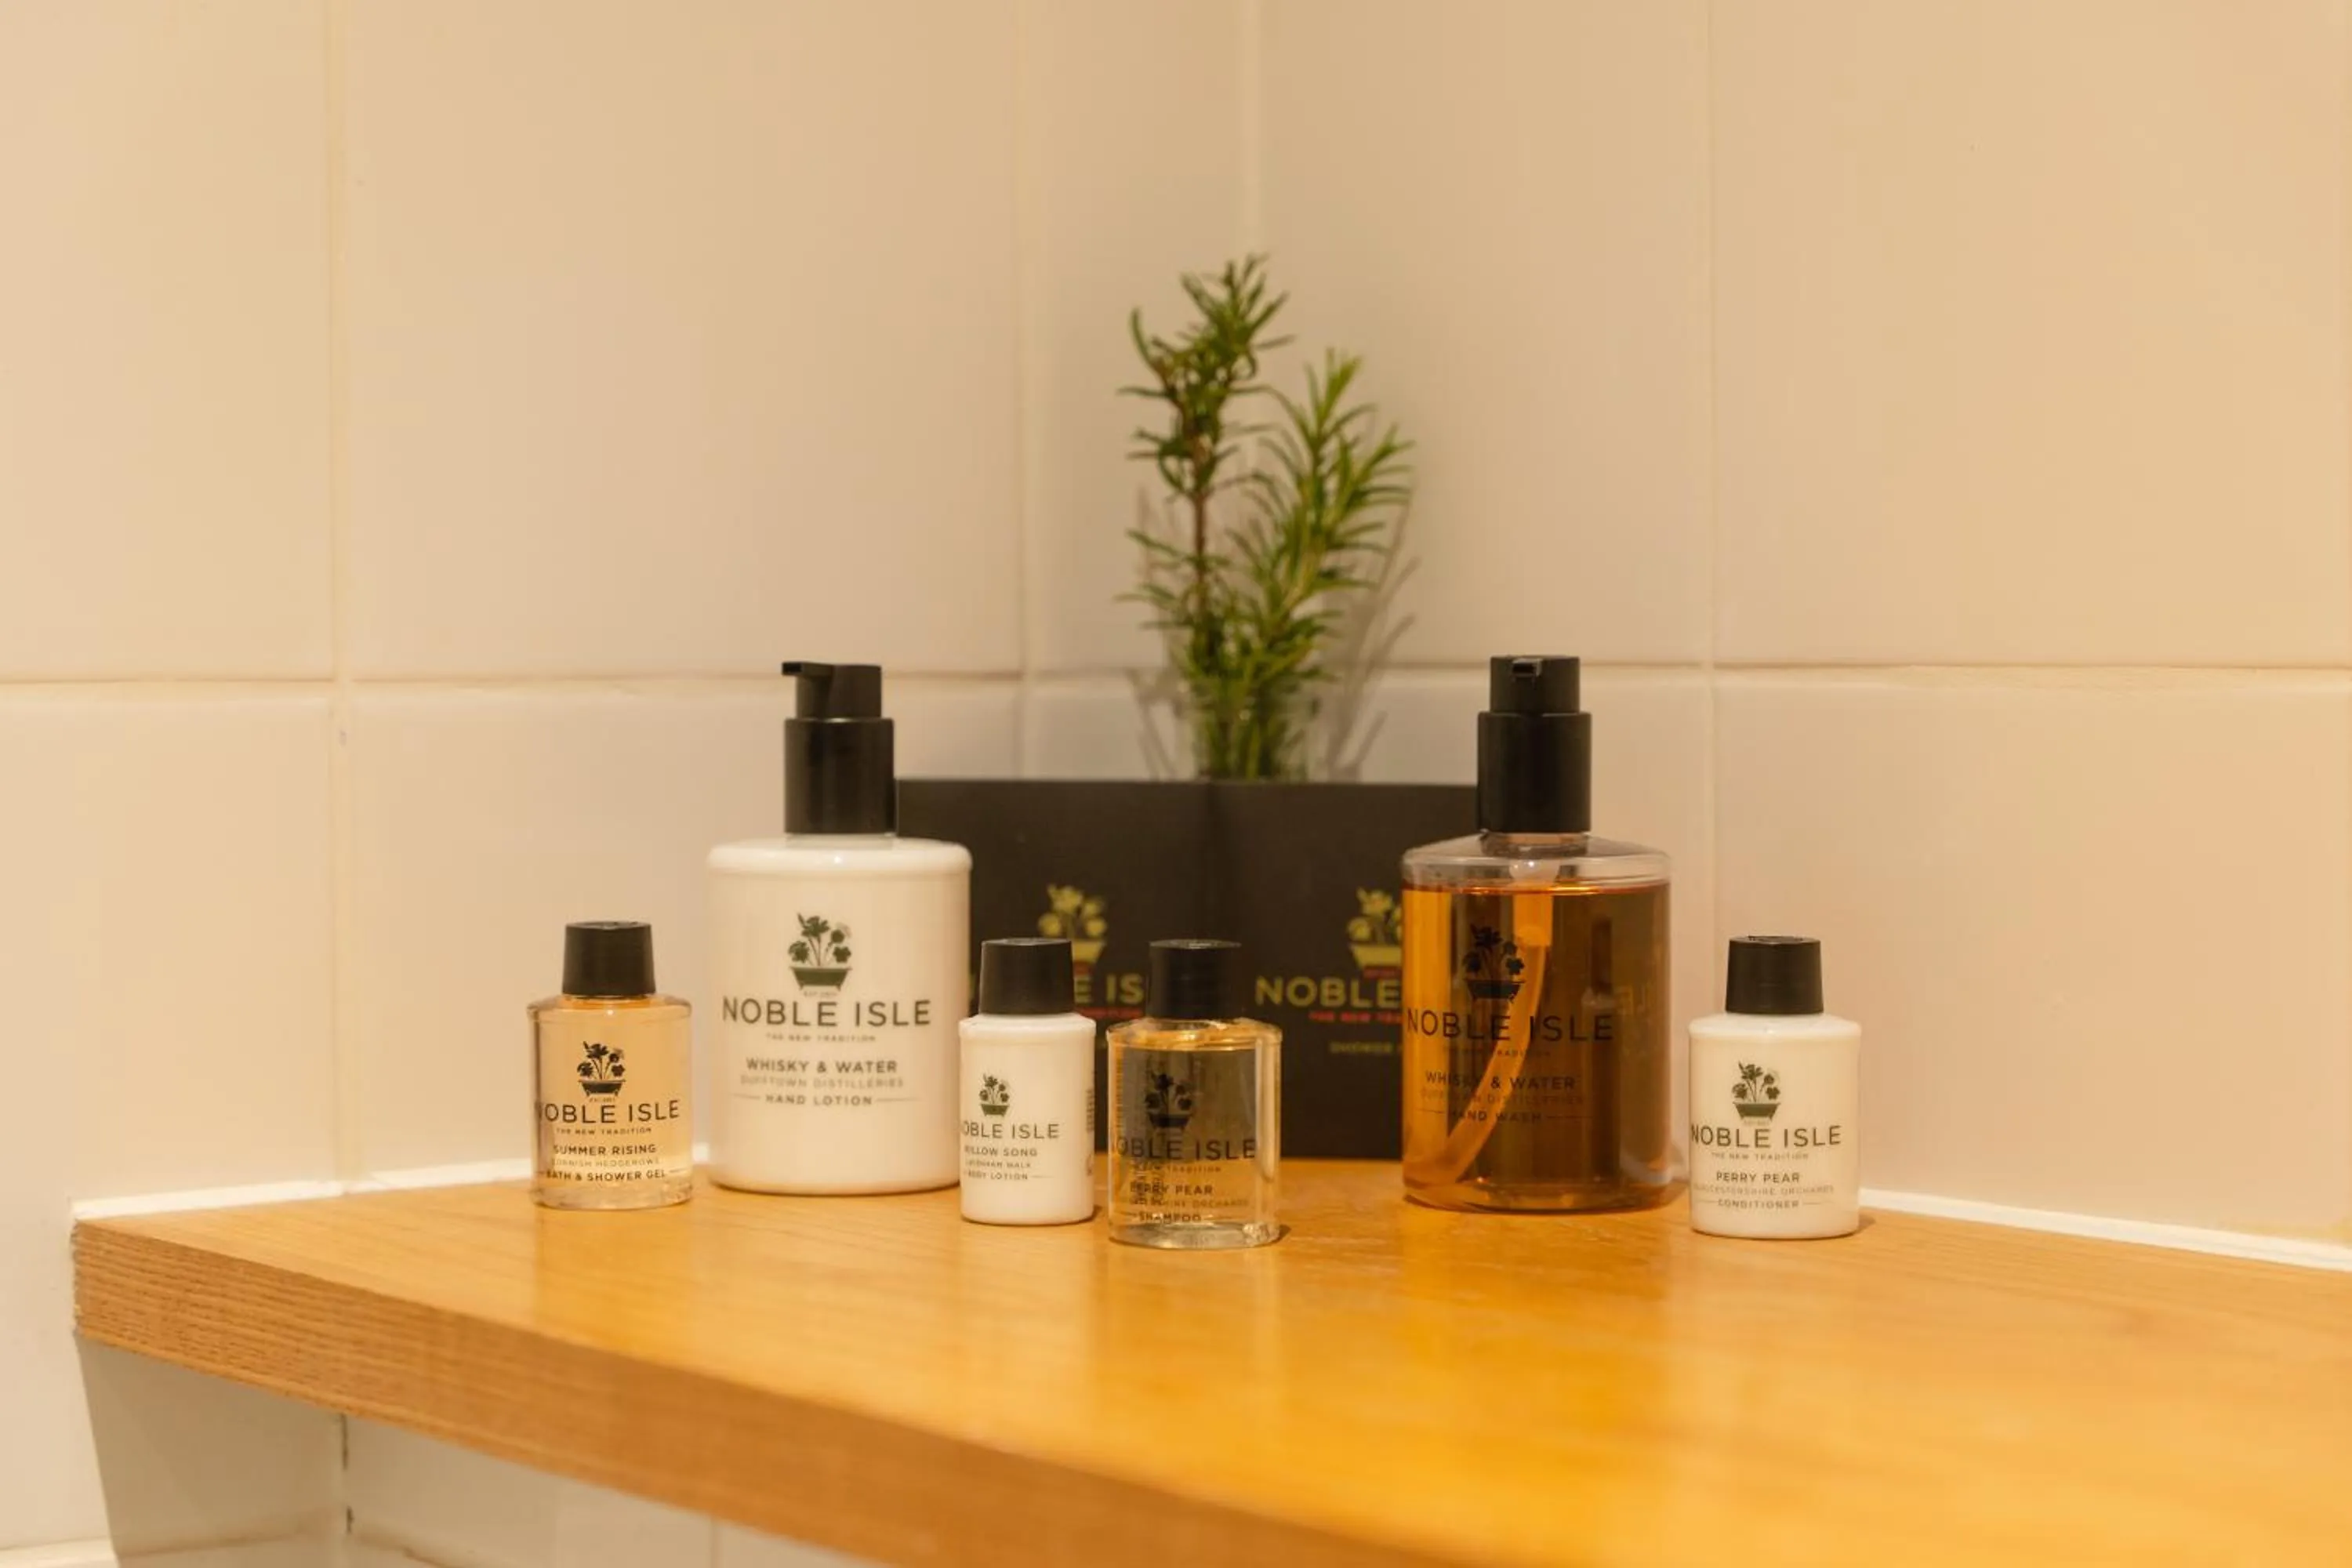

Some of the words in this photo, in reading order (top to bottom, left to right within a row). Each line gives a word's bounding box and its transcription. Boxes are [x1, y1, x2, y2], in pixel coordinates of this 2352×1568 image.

[1106, 973, 1145, 1005] IS
[1256, 976, 1399, 1010] NOBLE
[722, 996, 837, 1027] NOBLE
[855, 1000, 931, 1027] ISLE
[1406, 1007, 1510, 1041] NOBLE
[1530, 1015, 1613, 1042] ISLE
[746, 1058, 810, 1073] WHISKY
[816, 1060, 827, 1073] &
[836, 1060, 898, 1073] WATER
[813, 1076, 904, 1089] DISTILLERIES
[1490, 1076, 1501, 1089] &
[1510, 1076, 1575, 1090] WATER
[765, 1094, 806, 1105] HAND
[813, 1095, 873, 1106] LOTION
[629, 1100, 680, 1122] ISLE
[601, 1127, 652, 1135] TRADITION
[964, 1120, 1003, 1138] OBLE
[1012, 1123, 1060, 1139] ISLE
[1690, 1123, 1771, 1149] NOBLE
[1784, 1125, 1842, 1149] ISLE
[554, 1145, 606, 1156] SUMMER
[612, 1144, 656, 1155] RISING
[1004, 1147, 1038, 1158] SONG
[1116, 1137, 1182, 1160] OBLE
[1196, 1139, 1256, 1160] ISLE
[546, 1169, 572, 1180] BATH
[575, 1172, 583, 1181] &
[587, 1171, 642, 1182] SHOWER
[646, 1169, 666, 1179] GEL
[990, 1171, 1028, 1181] LOTION
[1716, 1171, 1757, 1183] PERRY
[1762, 1172, 1801, 1184] PEAR
[1175, 1185, 1214, 1196] PEAR
[1718, 1199, 1799, 1209] CONDITIONER
